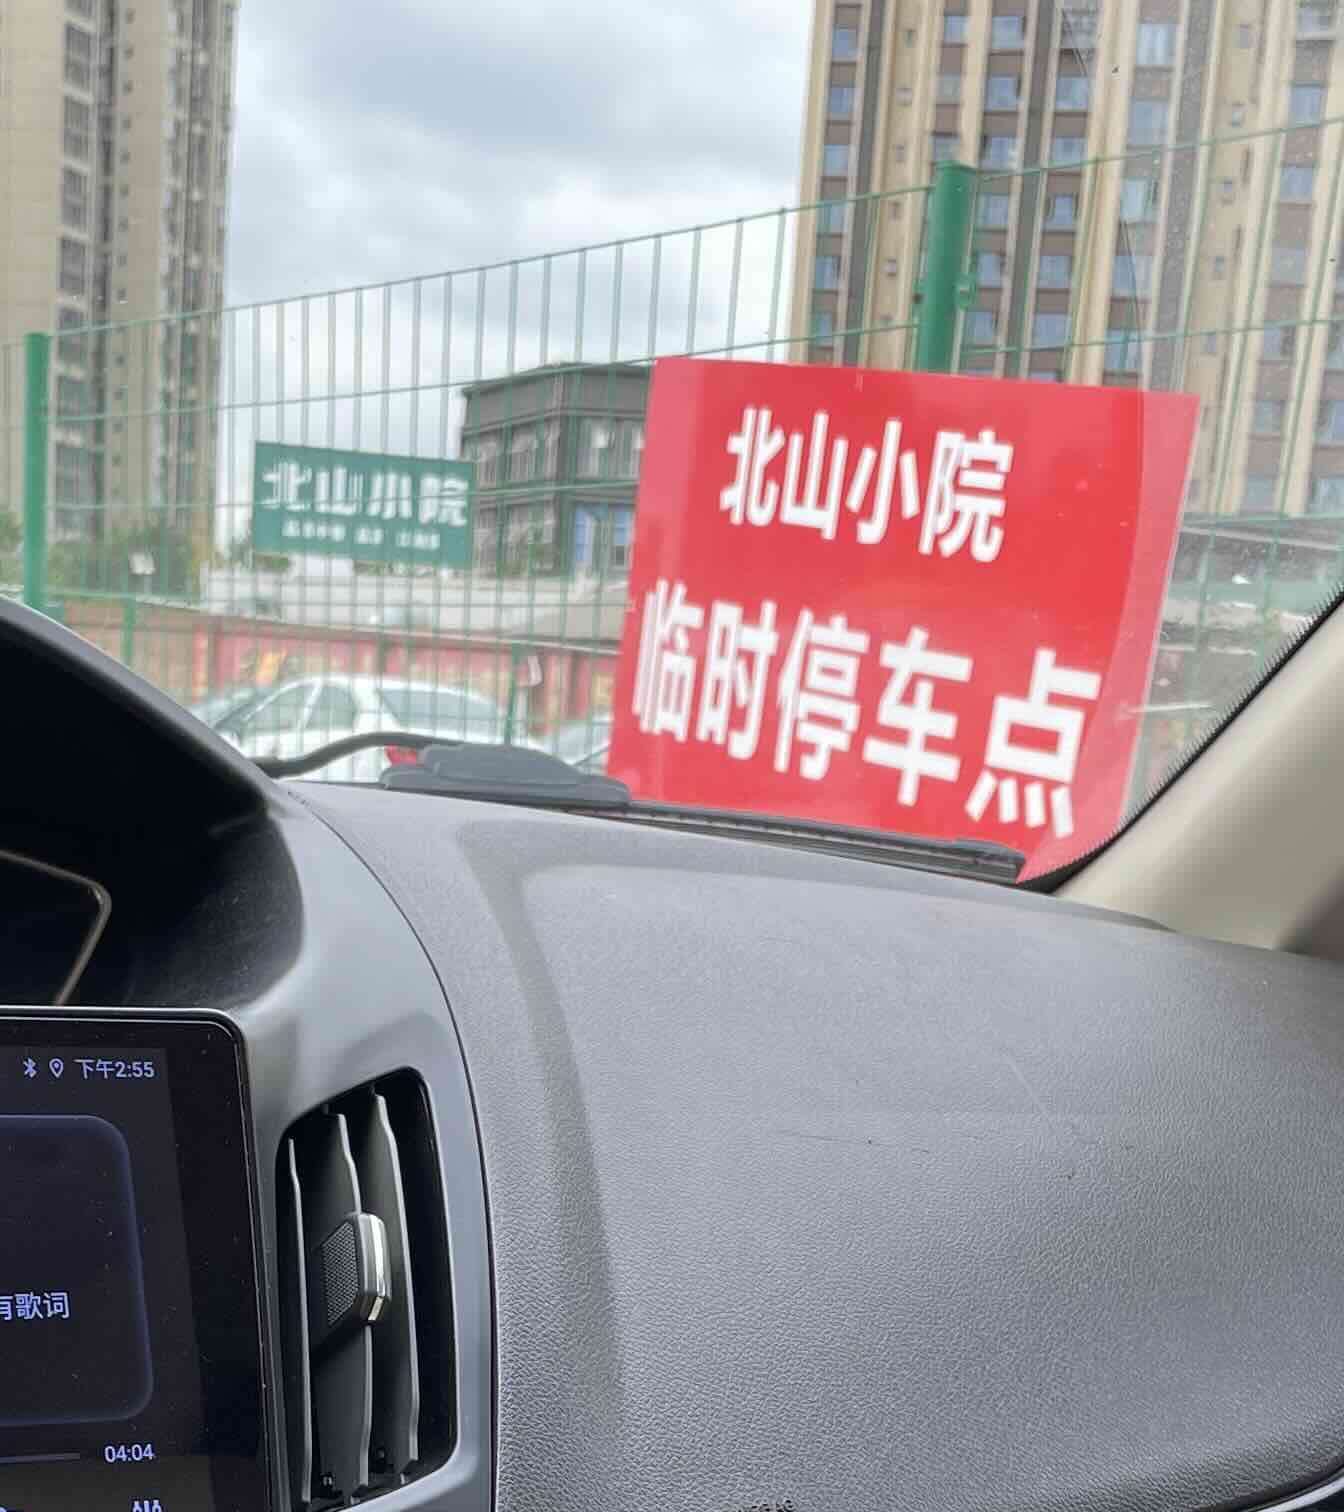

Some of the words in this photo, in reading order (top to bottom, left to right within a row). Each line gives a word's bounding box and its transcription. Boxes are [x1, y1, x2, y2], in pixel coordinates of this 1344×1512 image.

[261, 460, 469, 527] 北山小院
[719, 404, 1014, 563] 北山小院
[632, 578, 1102, 840] 临时停车点
[75, 1058, 155, 1079] 下午2:55
[104, 1444, 155, 1463] 04:04
